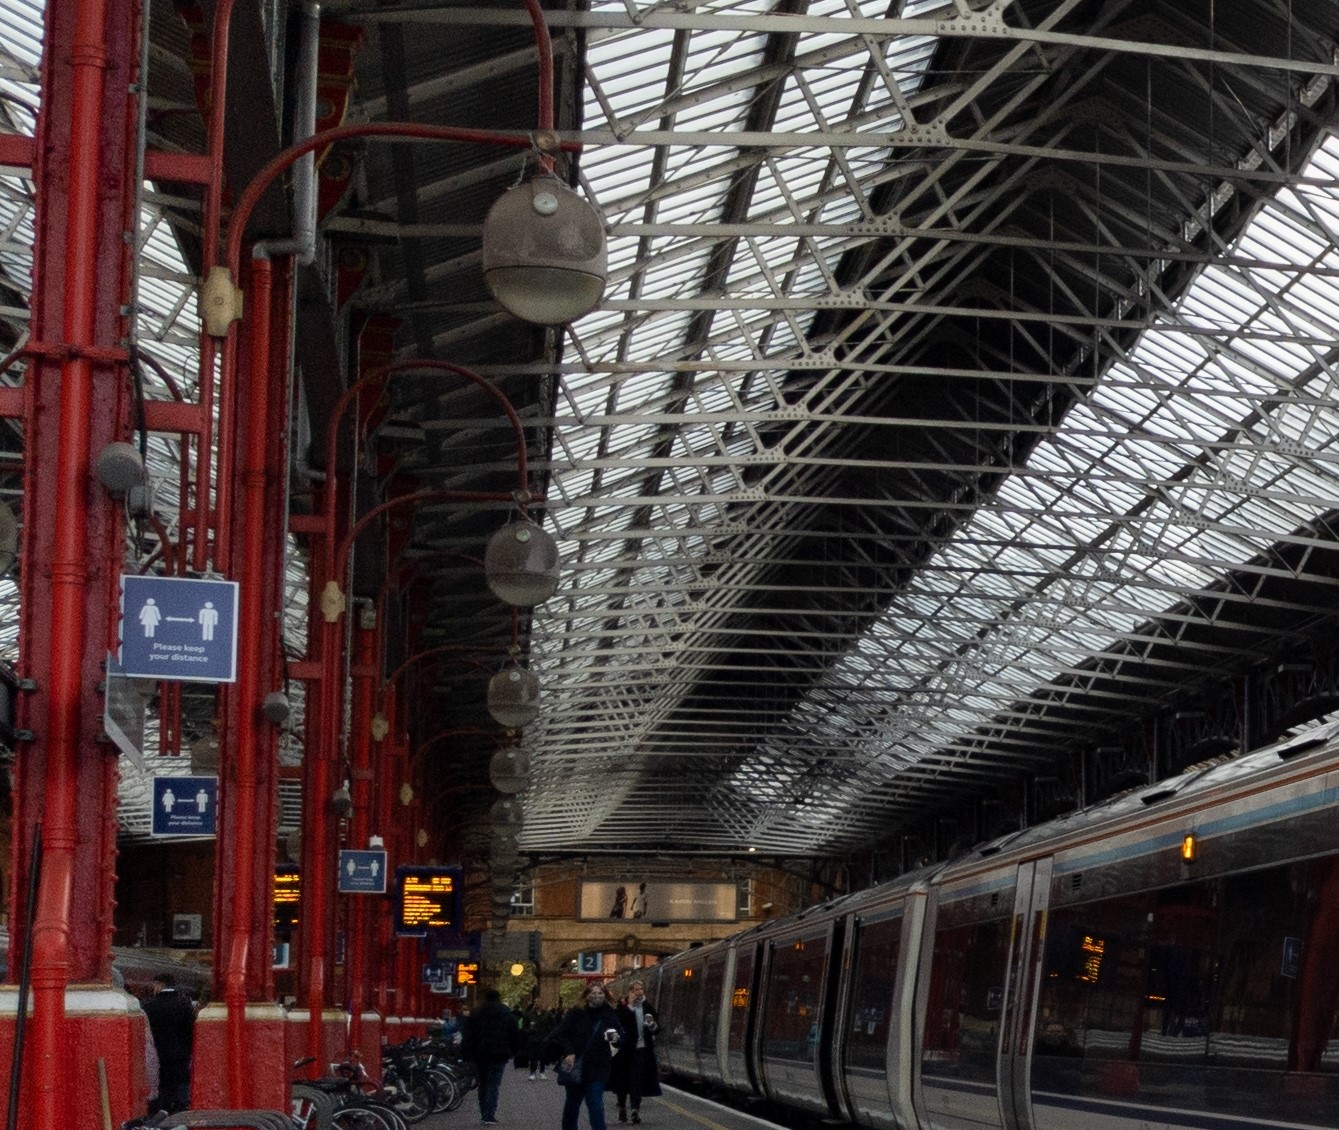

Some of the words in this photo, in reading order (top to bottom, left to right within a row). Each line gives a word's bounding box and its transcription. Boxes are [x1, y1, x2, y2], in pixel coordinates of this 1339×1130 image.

[153, 642, 183, 652] Please
[184, 644, 205, 654] keep
[149, 653, 169, 661] your
[171, 653, 209, 663] distance
[586, 957, 594, 967] 2
